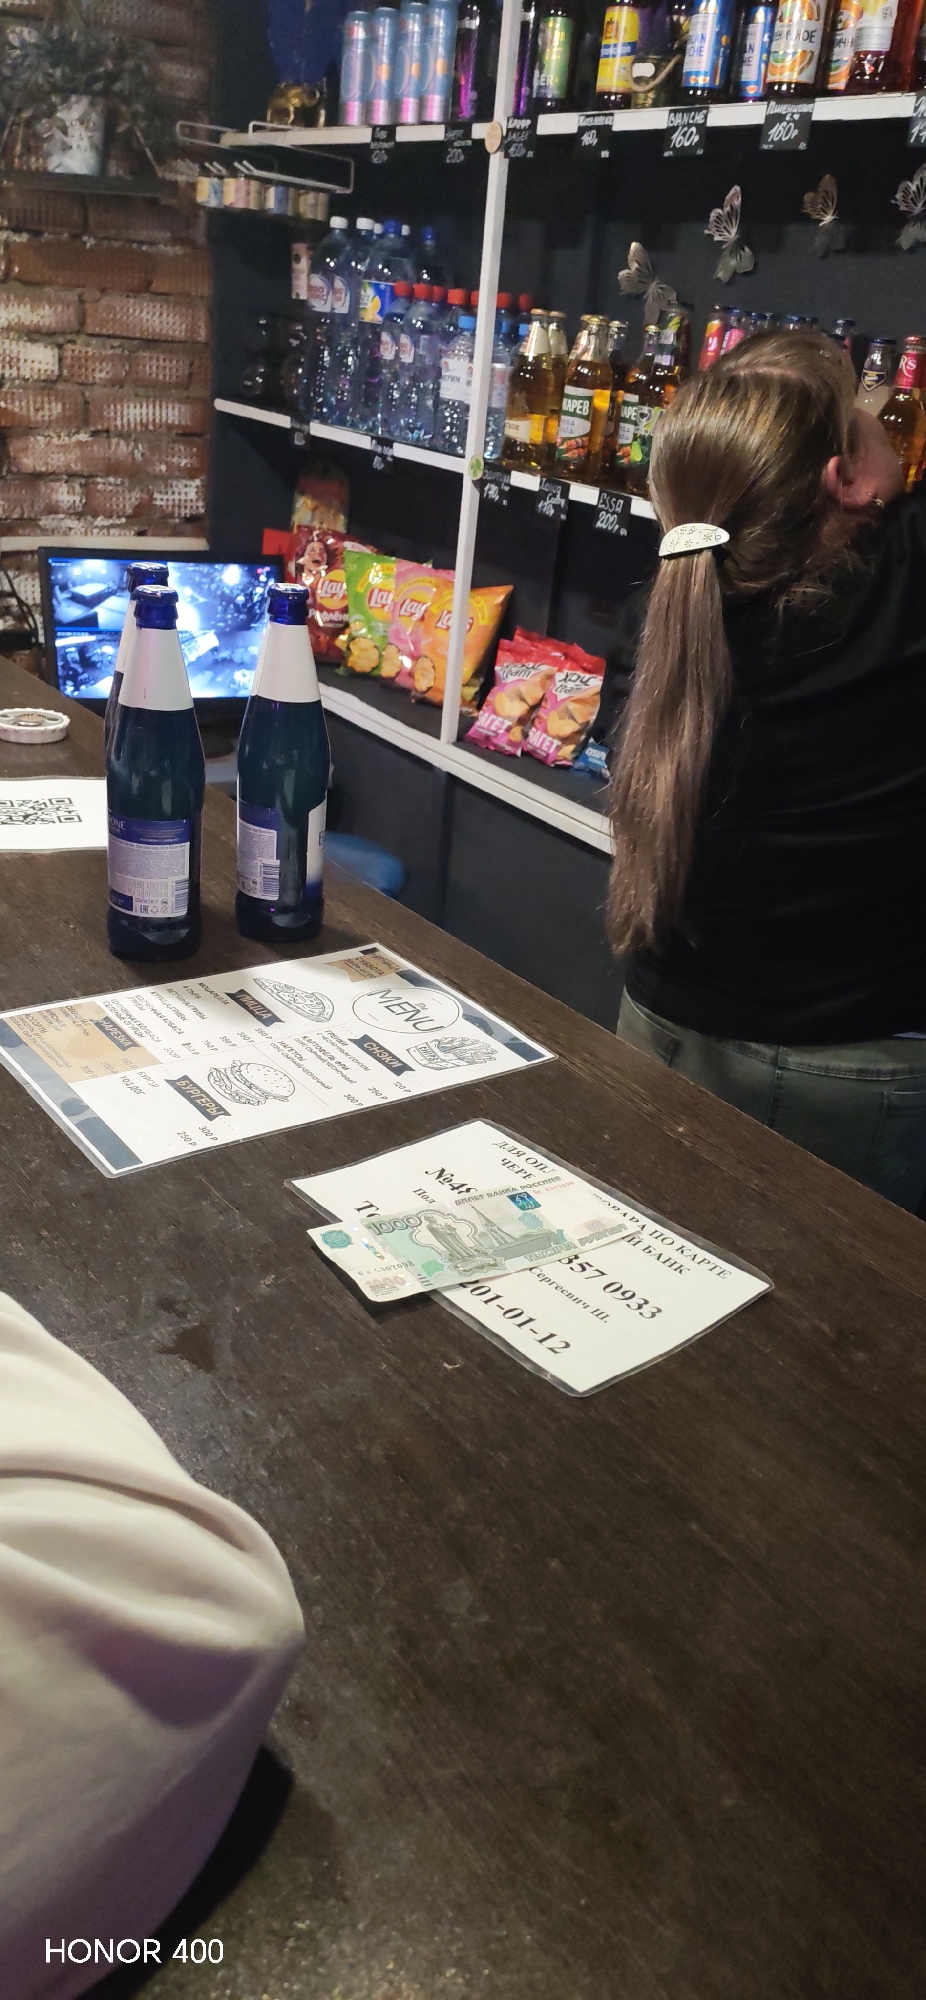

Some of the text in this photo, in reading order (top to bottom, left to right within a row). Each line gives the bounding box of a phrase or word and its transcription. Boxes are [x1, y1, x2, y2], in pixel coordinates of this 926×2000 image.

[478, 711, 513, 734] АГЕТ
[237, 994, 273, 1019] ПИЦЦА
[367, 989, 445, 1031] MENU
[98, 1019, 133, 1047] НАРЕЗКА
[364, 1042, 403, 1067] СНЭКИ
[176, 1080, 224, 1115] БУРГЕРЫ
[177, 1131, 192, 1142] 250
[198, 1126, 213, 1136] 300
[455, 1176, 562, 1206] БИЛЕТ БАНКА РОССИИ
[365, 1214, 422, 1236] 1000
[491, 1141, 526, 1157] ДЛЯ
[648, 1229, 675, 1246] ПО
[673, 1244, 732, 1279] КАРТЕ
[524, 1241, 578, 1262] ТЫСЯЧА
[577, 1223, 628, 1246] РУБЛЕЙ
[641, 1244, 691, 1276] БАНК
[529, 1266, 591, 1310] Сергеевич
[602, 1281, 662, 1319] 0933
